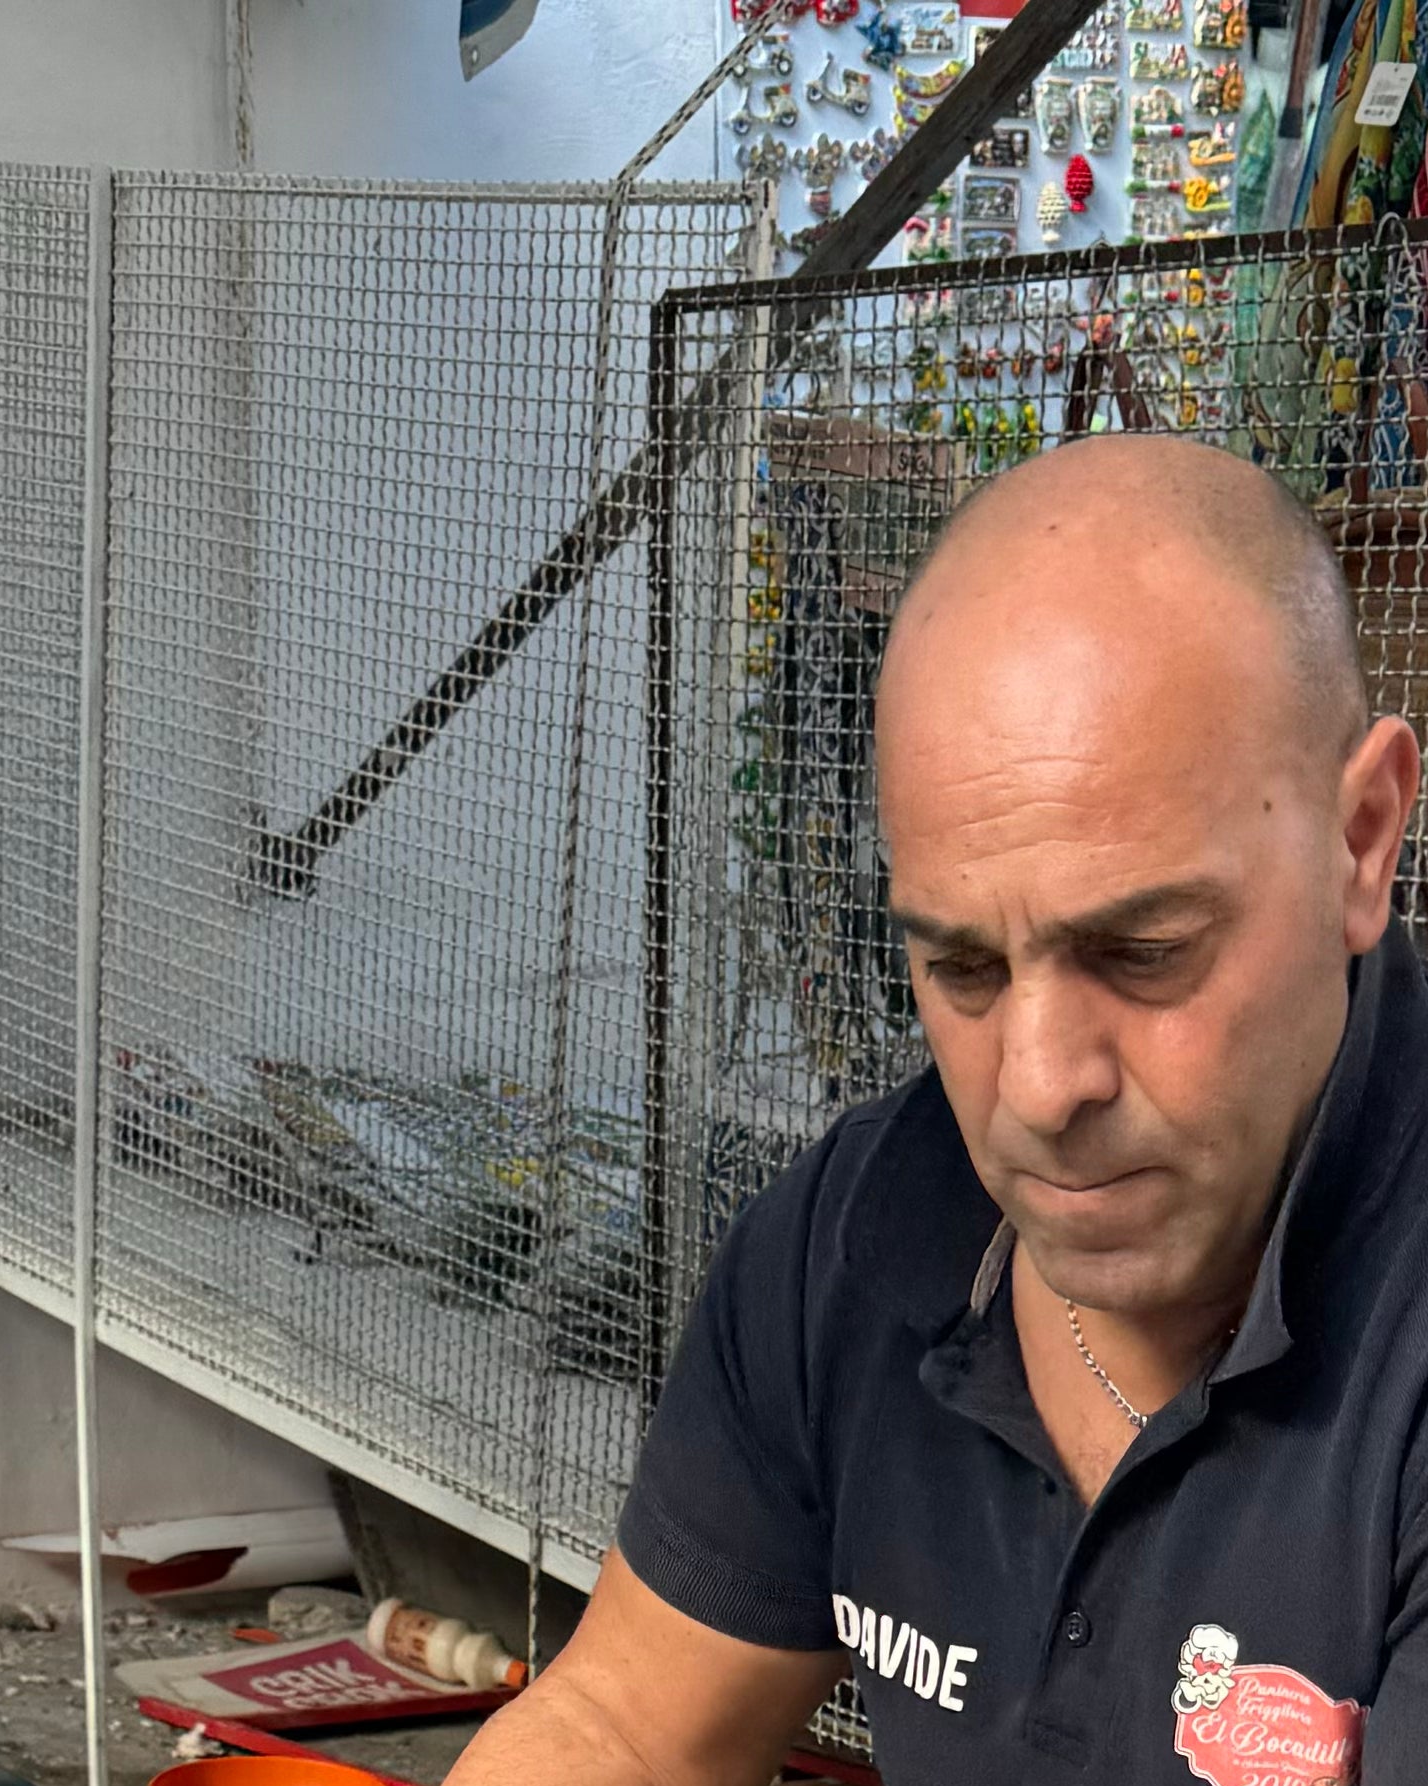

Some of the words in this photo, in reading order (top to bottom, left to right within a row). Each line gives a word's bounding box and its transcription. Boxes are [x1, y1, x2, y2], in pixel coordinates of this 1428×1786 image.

[249, 1657, 377, 1697] CRIK
[833, 1593, 977, 1712] DAVIDE
[1191, 1711, 1227, 1744] El
[1229, 1720, 1355, 1766] Bocadill
